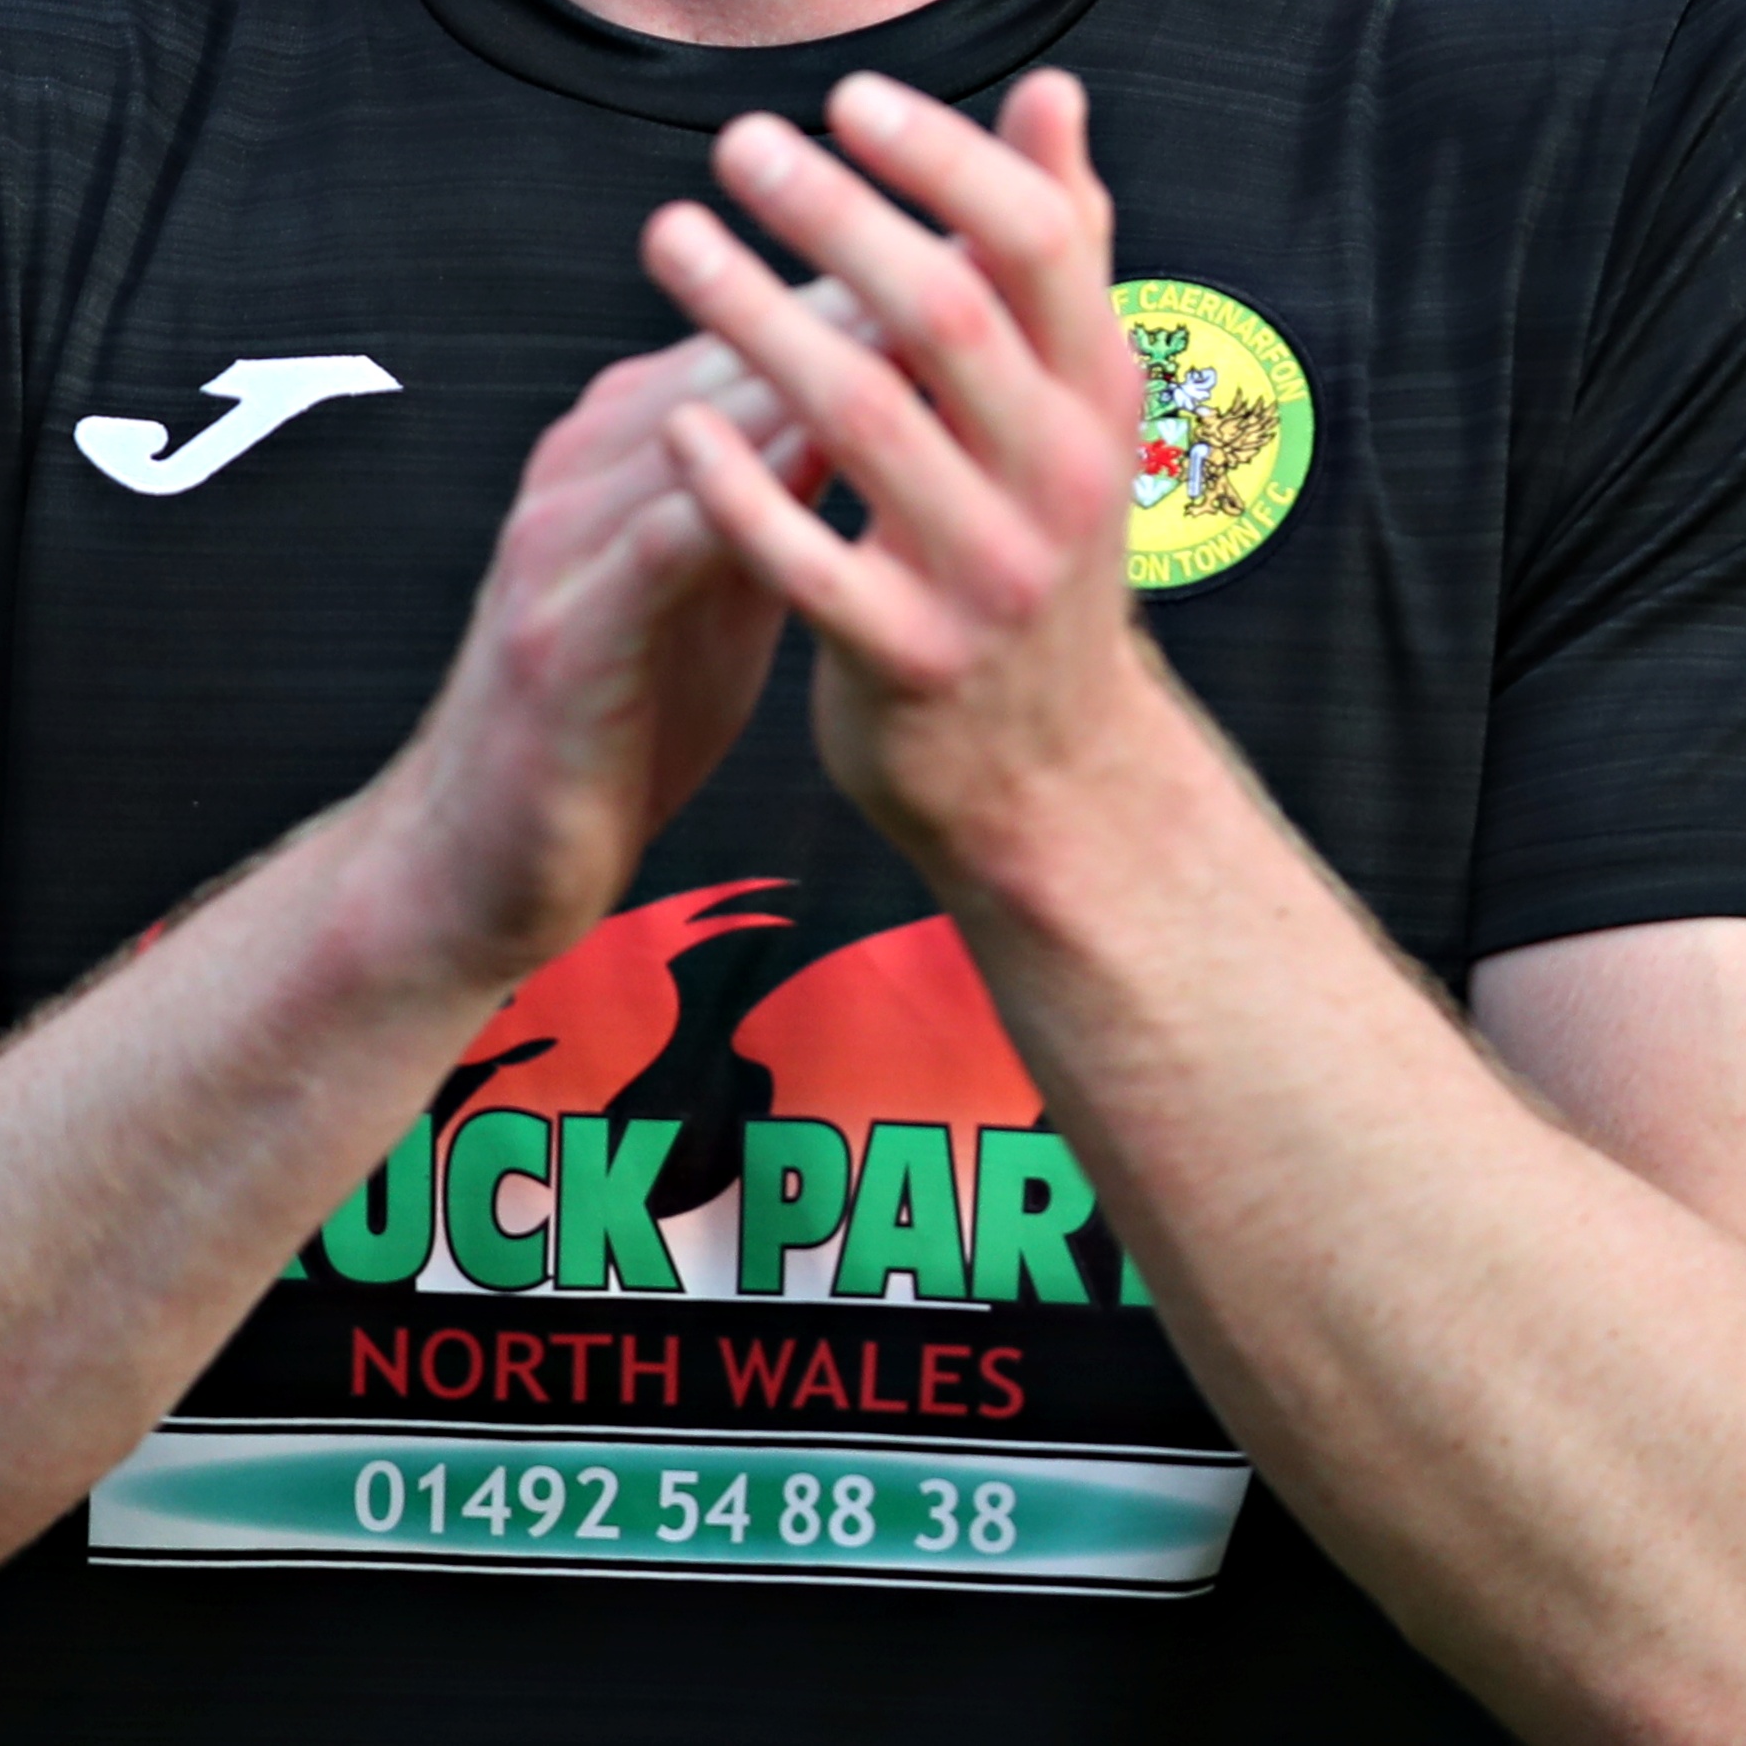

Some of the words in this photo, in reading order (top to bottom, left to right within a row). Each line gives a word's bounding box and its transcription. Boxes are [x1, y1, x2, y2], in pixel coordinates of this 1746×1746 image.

[1139, 281, 1308, 403] CAERNARFON
[1173, 516, 1262, 578] TOWN
[736, 1114, 1156, 1308] PAR
[350, 1326, 681, 1406] NORTH
[717, 1337, 1026, 1419] WALES
[353, 1459, 622, 1540] 01492
[656, 1469, 752, 1545] 54
[778, 1471, 877, 1548] 88
[913, 1478, 1018, 1554] 38
